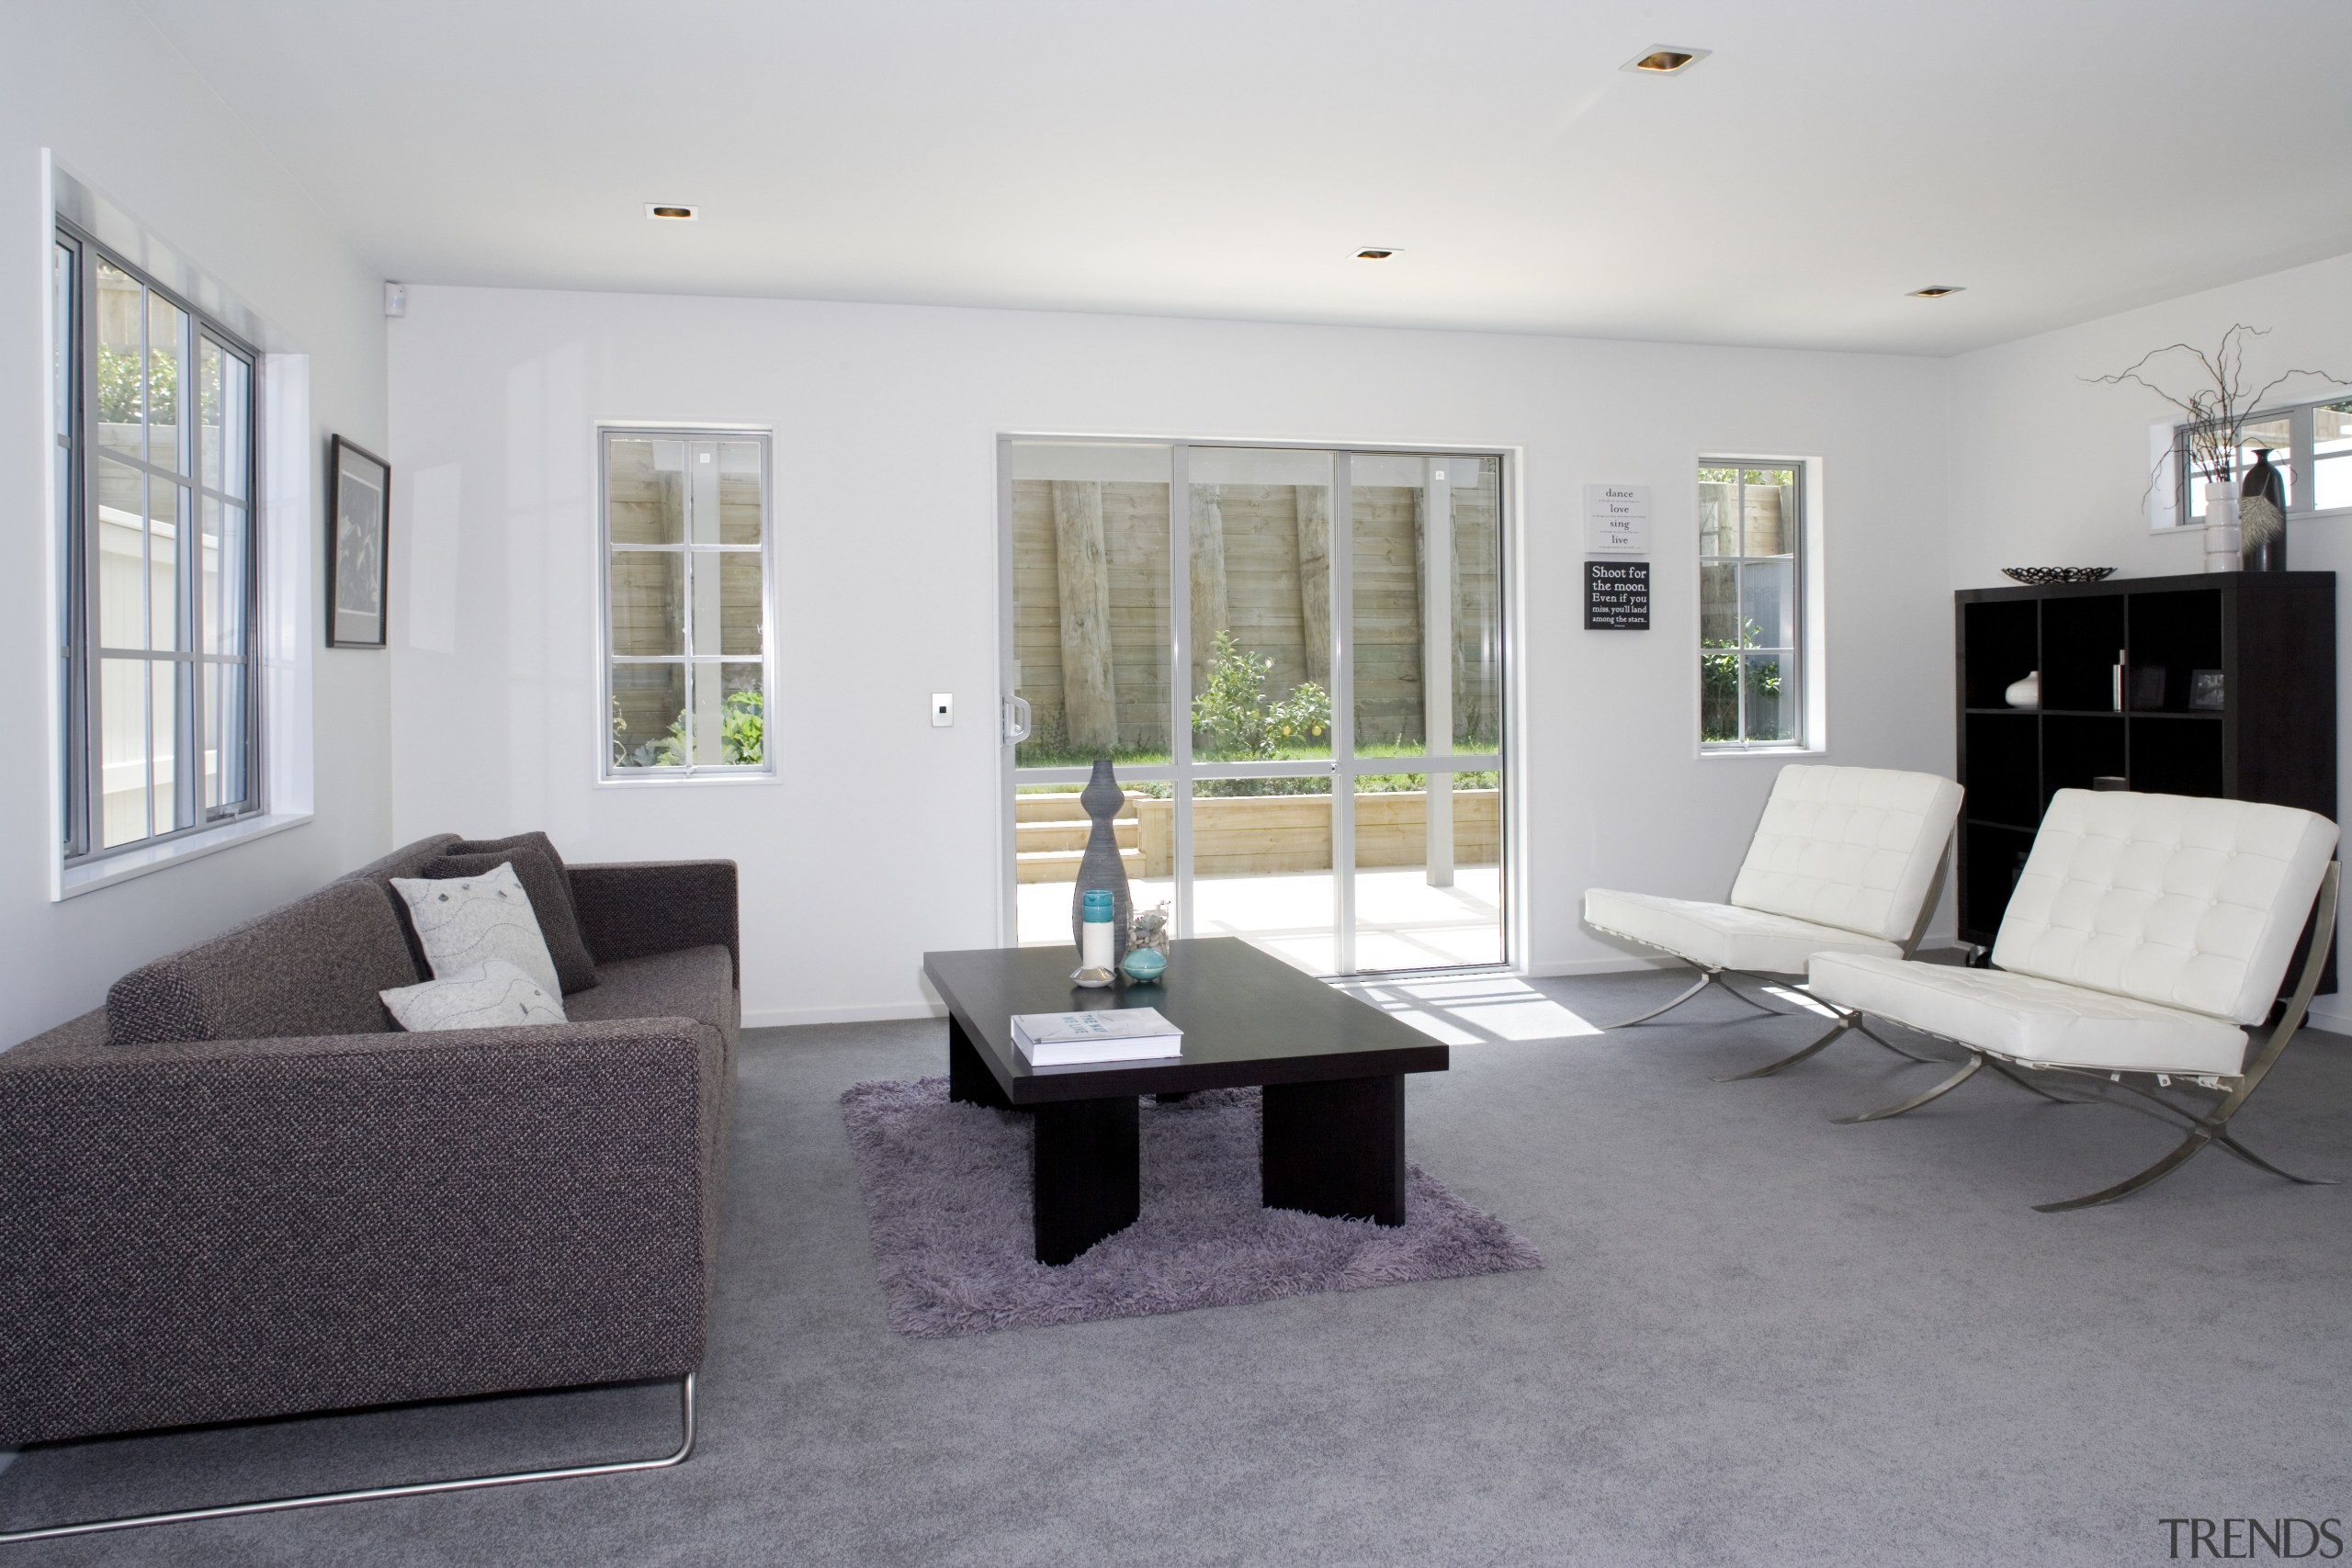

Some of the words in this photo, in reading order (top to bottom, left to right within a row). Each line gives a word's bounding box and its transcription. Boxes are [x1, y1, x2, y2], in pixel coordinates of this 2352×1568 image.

[1606, 488, 1634, 498] dance
[1610, 503, 1630, 513] love
[1610, 519, 1630, 530] sing
[1611, 535, 1628, 544] live
[1592, 565, 1626, 578] Shoot
[1629, 566, 1647, 579] for
[1592, 580, 1611, 591] the
[1614, 583, 1647, 592] moon.
[1592, 592, 1617, 603] Even
[1619, 593, 1628, 603] if
[1629, 595, 1647, 605] you
[1611, 605, 1630, 615] you'll
